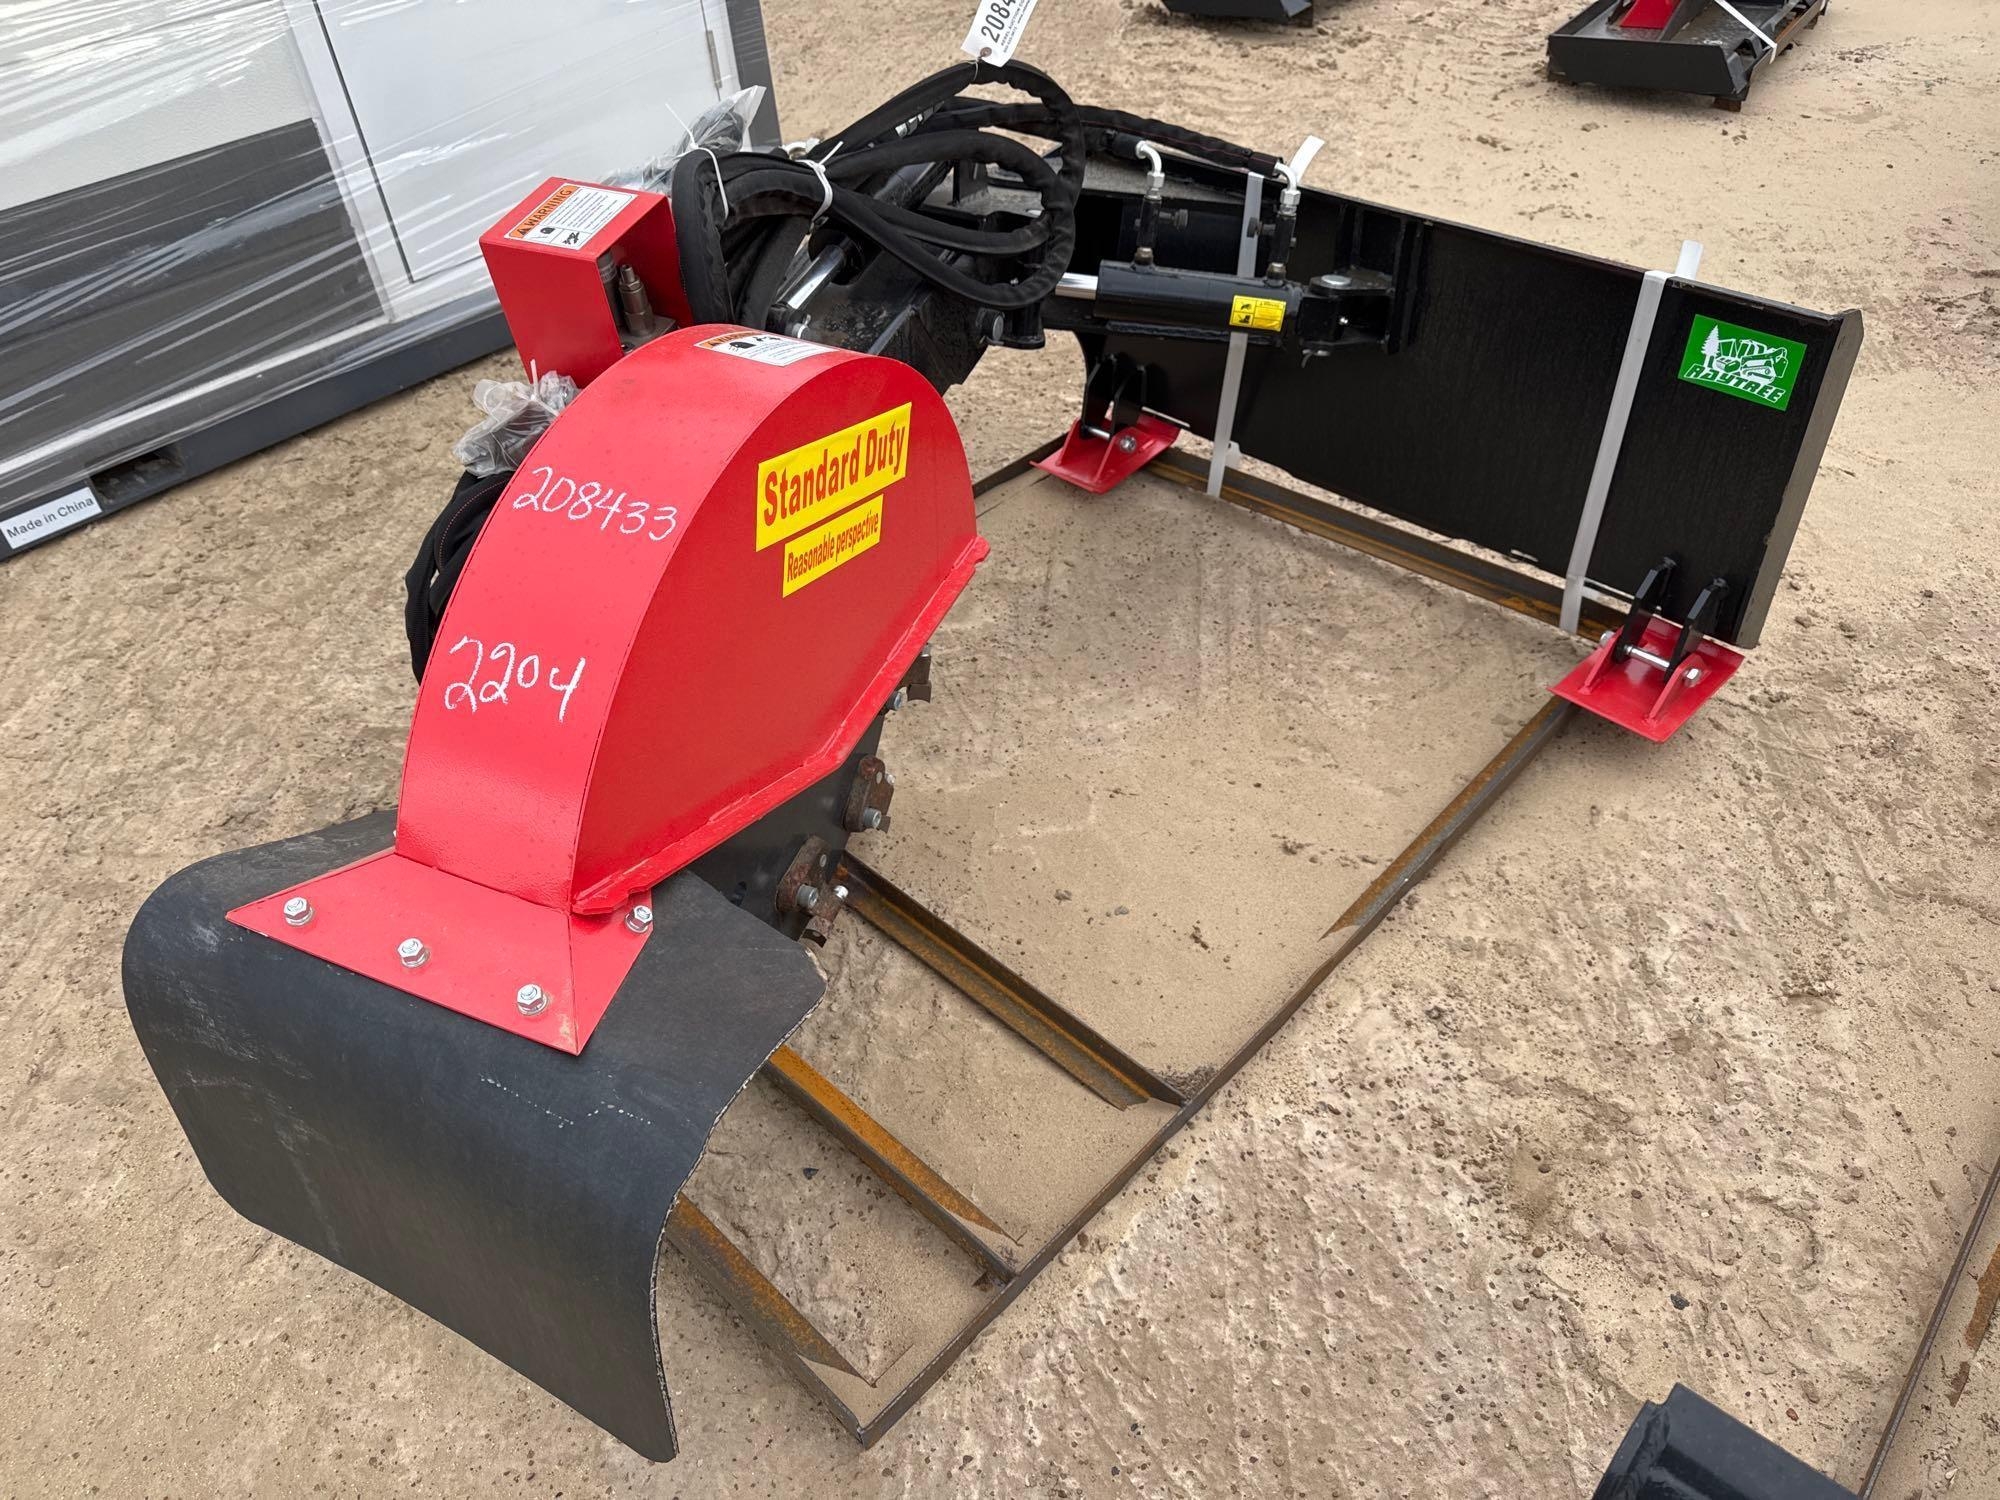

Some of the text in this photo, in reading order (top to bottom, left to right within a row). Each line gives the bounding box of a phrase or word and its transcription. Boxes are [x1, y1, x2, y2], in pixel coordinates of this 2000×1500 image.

[523, 189, 573, 230] WARNING
[1684, 363, 1786, 403] RAYTREE
[513, 466, 678, 541] 208433
[764, 421, 905, 526] Standard Duty
[7, 498, 94, 538] Made in China
[787, 509, 879, 583] Reasonable perspective
[445, 636, 586, 723] 2204
